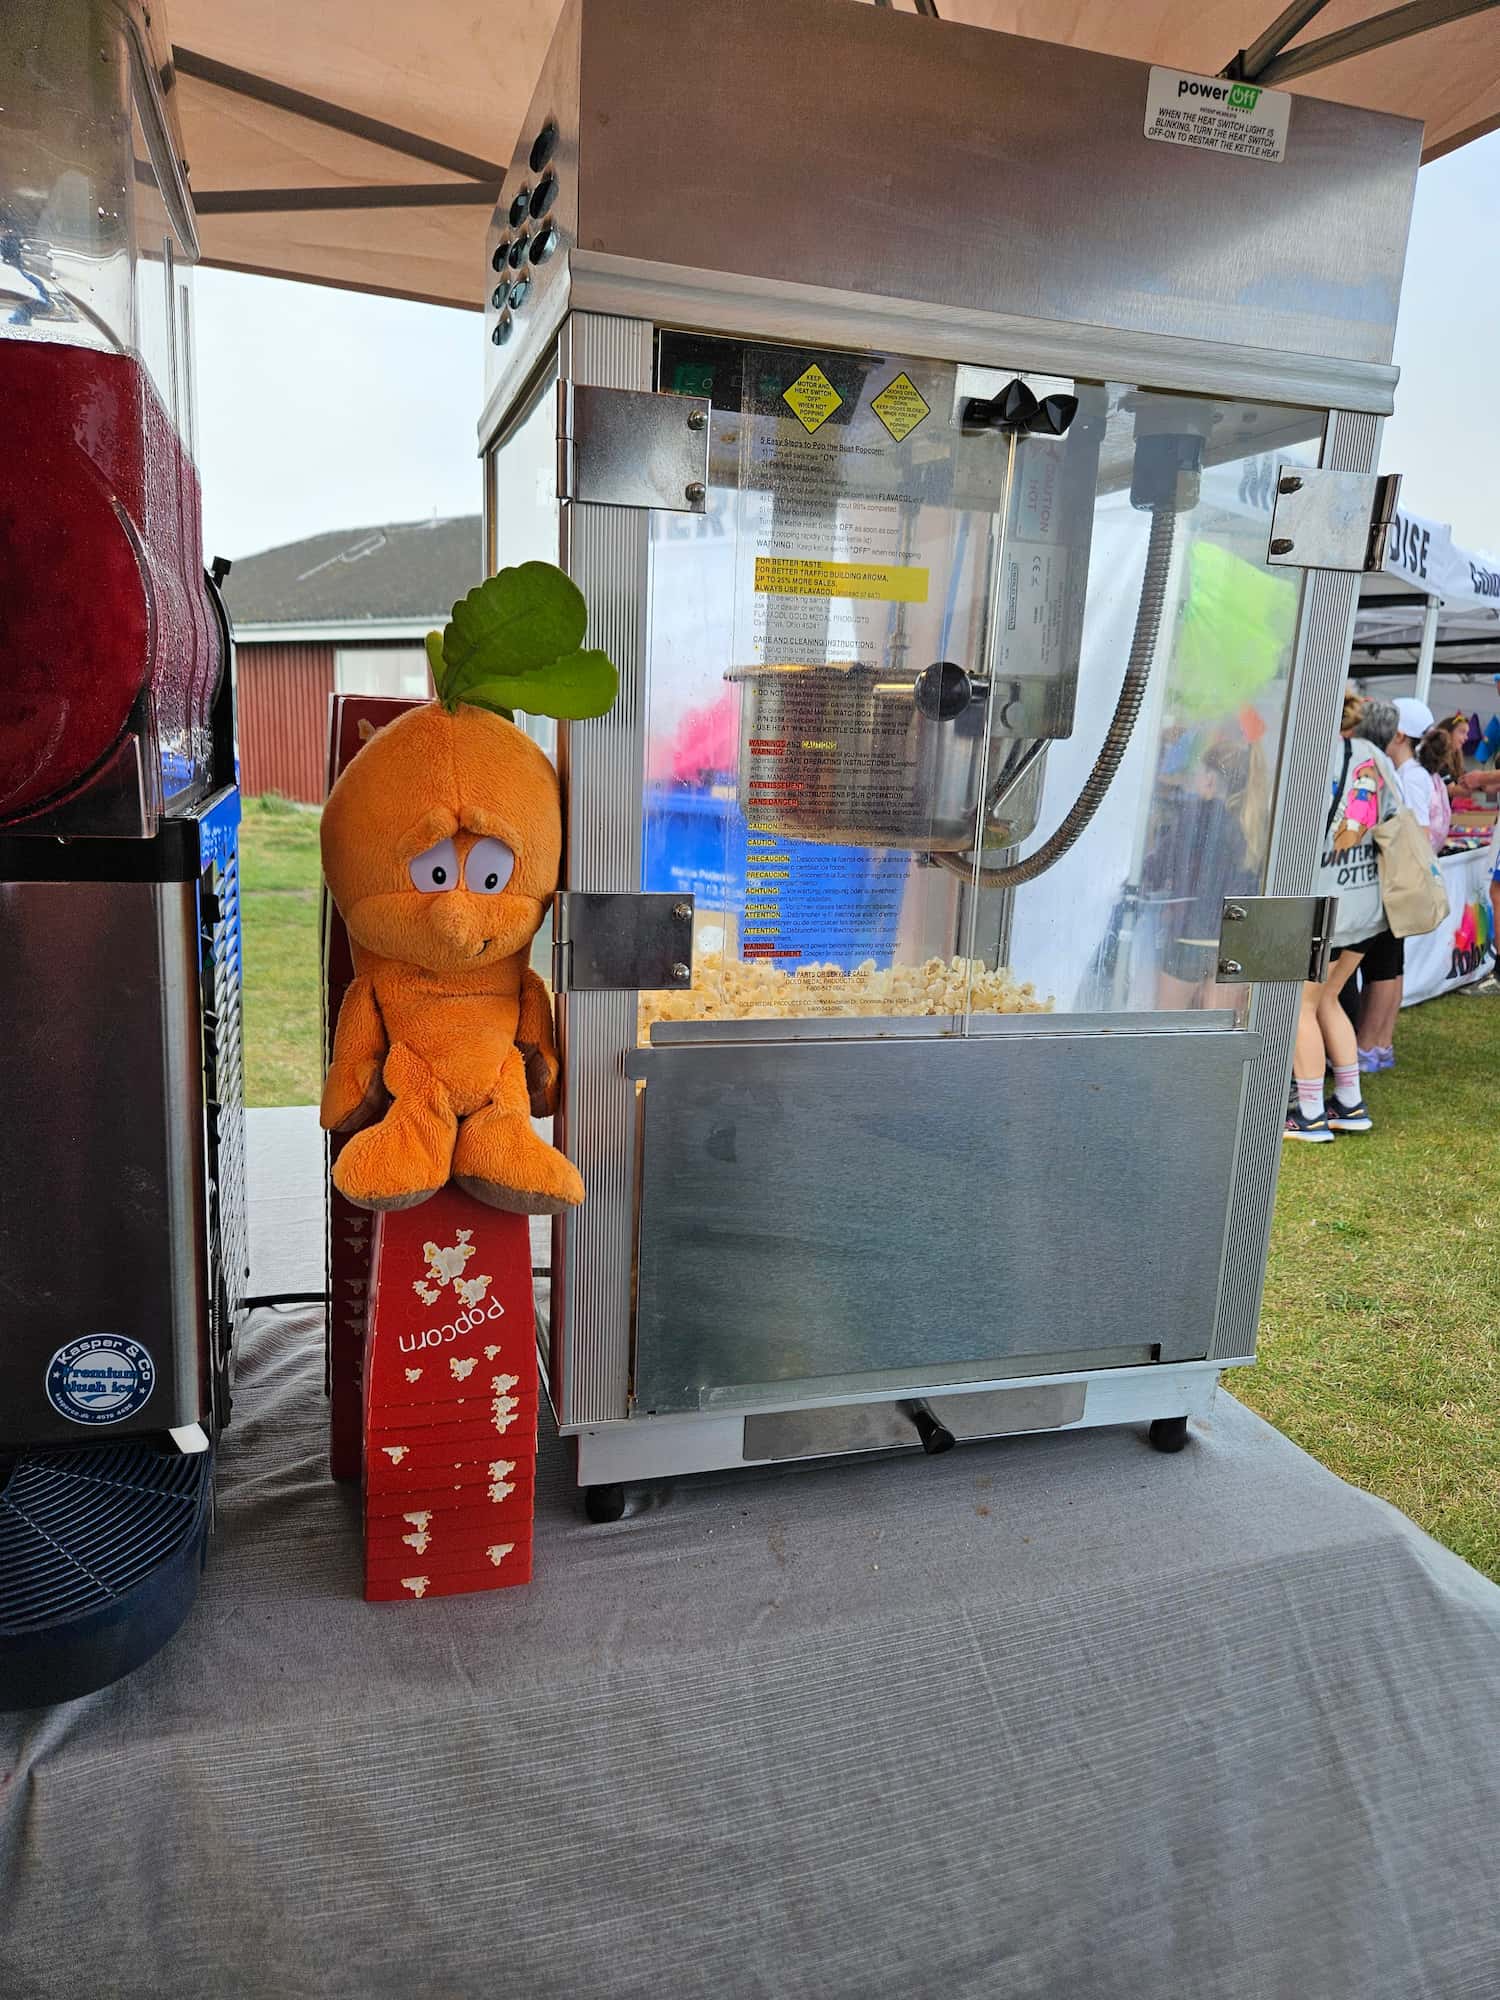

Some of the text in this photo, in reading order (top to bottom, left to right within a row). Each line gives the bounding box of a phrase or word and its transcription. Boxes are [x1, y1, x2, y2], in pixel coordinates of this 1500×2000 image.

[1160, 107, 1275, 138] WHEN THE HEAT SWITCH LIGHT IS
[1193, 124, 1213, 136] TURN
[1214, 128, 1228, 139] THE
[1228, 132, 1248, 142] HEAT
[1248, 135, 1275, 148] SWITCH
[1148, 127, 1280, 158] OFF-ON TO RESTART THE KETTLE HEAT
[810, 389, 832, 397] SWITCH
[766, 437, 783, 447] Easy
[784, 438, 803, 449] Steps
[804, 440, 811, 449] to
[811, 441, 826, 451] Pop
[839, 523, 854, 532] OFF
[755, 557, 771, 565] FOR
[771, 558, 799, 567] BETTER
[755, 565, 770, 574] FOR
[771, 567, 799, 576] BETTER
[800, 569, 829, 578] TRAFFIC
[829, 571, 862, 580] BUILDING
[755, 574, 765, 582] UP
[767, 575, 776, 583] TO
[777, 576, 791, 584] 25%
[792, 577, 813, 586] MORE
[755, 583, 835, 596] ALWAYS USE FLAVACOL
[752, 634, 773, 644] CARE
[773, 636, 789, 645] AND
[789, 637, 825, 647] CLEANING
[822, 726, 848, 735] KETTLE
[784, 756, 801, 766] SAFE
[802, 758, 842, 767] OPERATING
[842, 759, 890, 768] INSTRUCTIONS
[846, 791, 865, 800] POUR
[866, 791, 904, 801] OPERATION
[747, 838, 777, 847] CAUTION
[743, 927, 780, 936] ATTENTION
[796, 971, 816, 979] PARTS
[399, 1295, 505, 1353] Popcorn
[57, 1340, 151, 1381] Kasper & Co
[62, 1366, 139, 1379] Premium
[111, 1381, 136, 1393] ice
